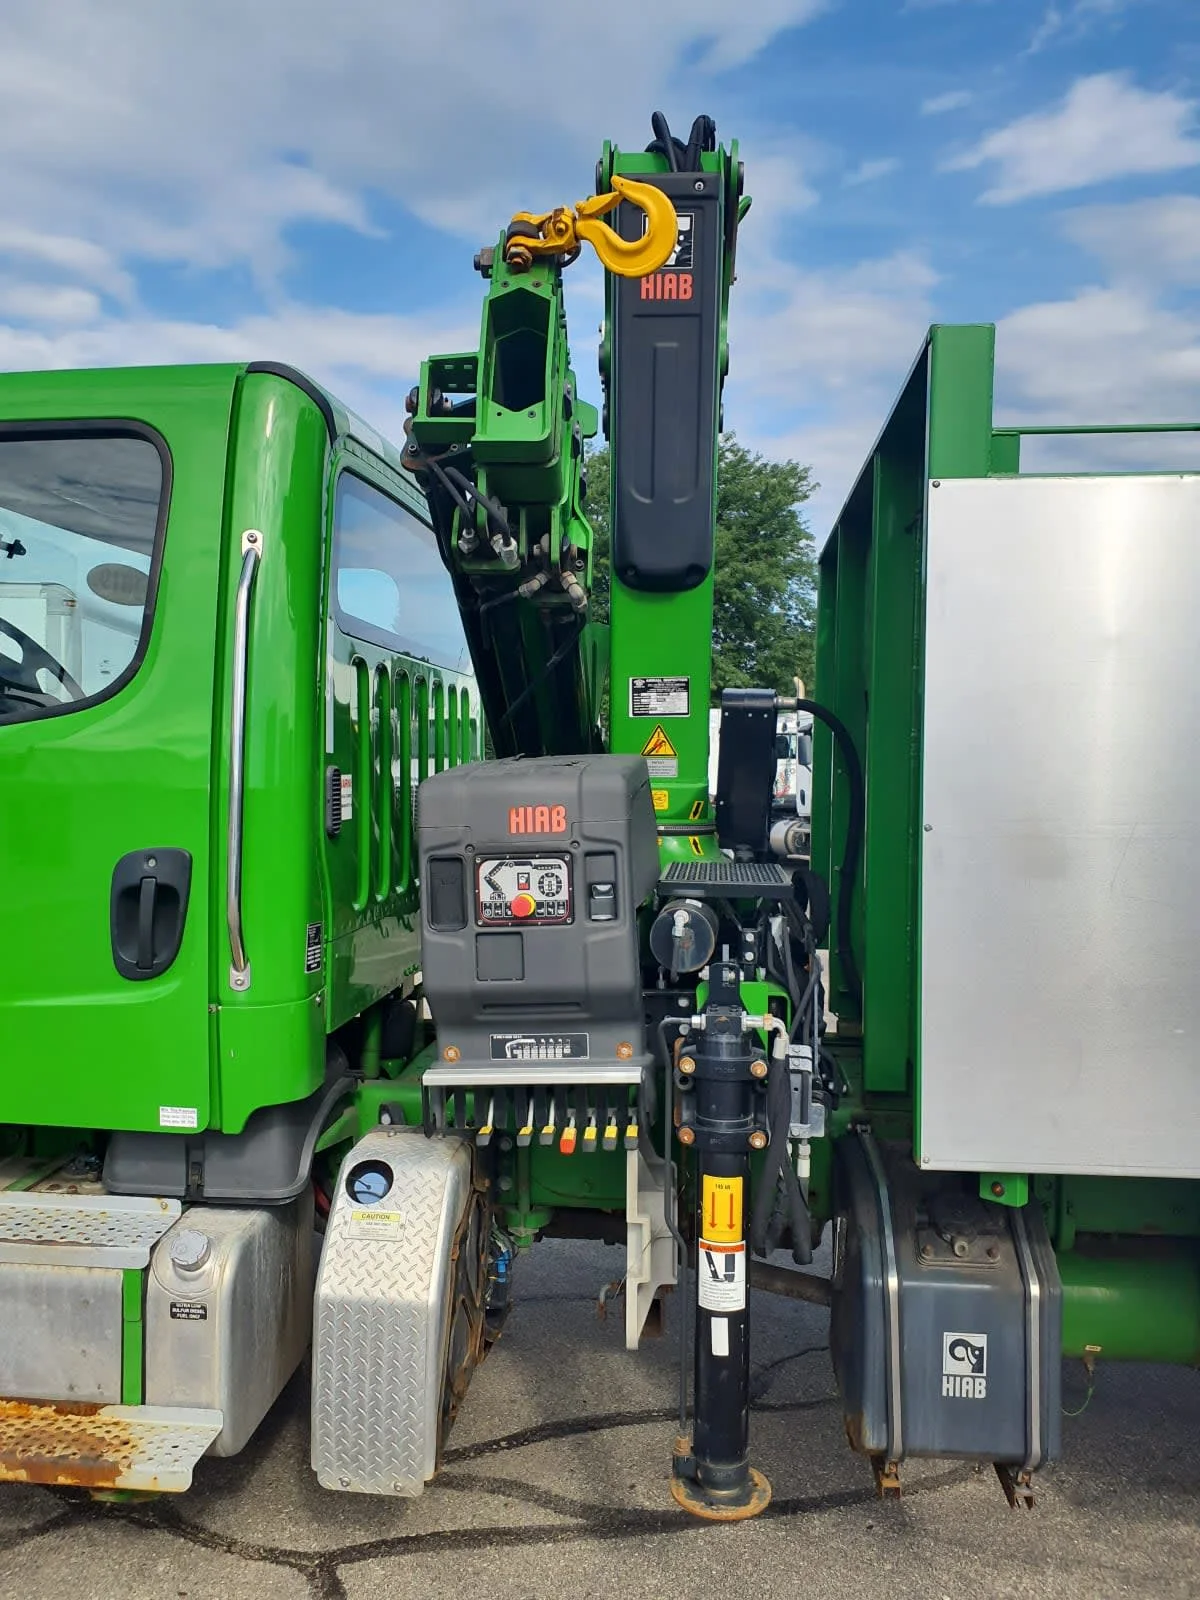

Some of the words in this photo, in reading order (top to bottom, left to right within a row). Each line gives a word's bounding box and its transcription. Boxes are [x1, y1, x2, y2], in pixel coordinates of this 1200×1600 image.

[641, 273, 693, 300] HIAB
[510, 806, 566, 834] HIAB
[942, 1375, 987, 1399] HIAB
